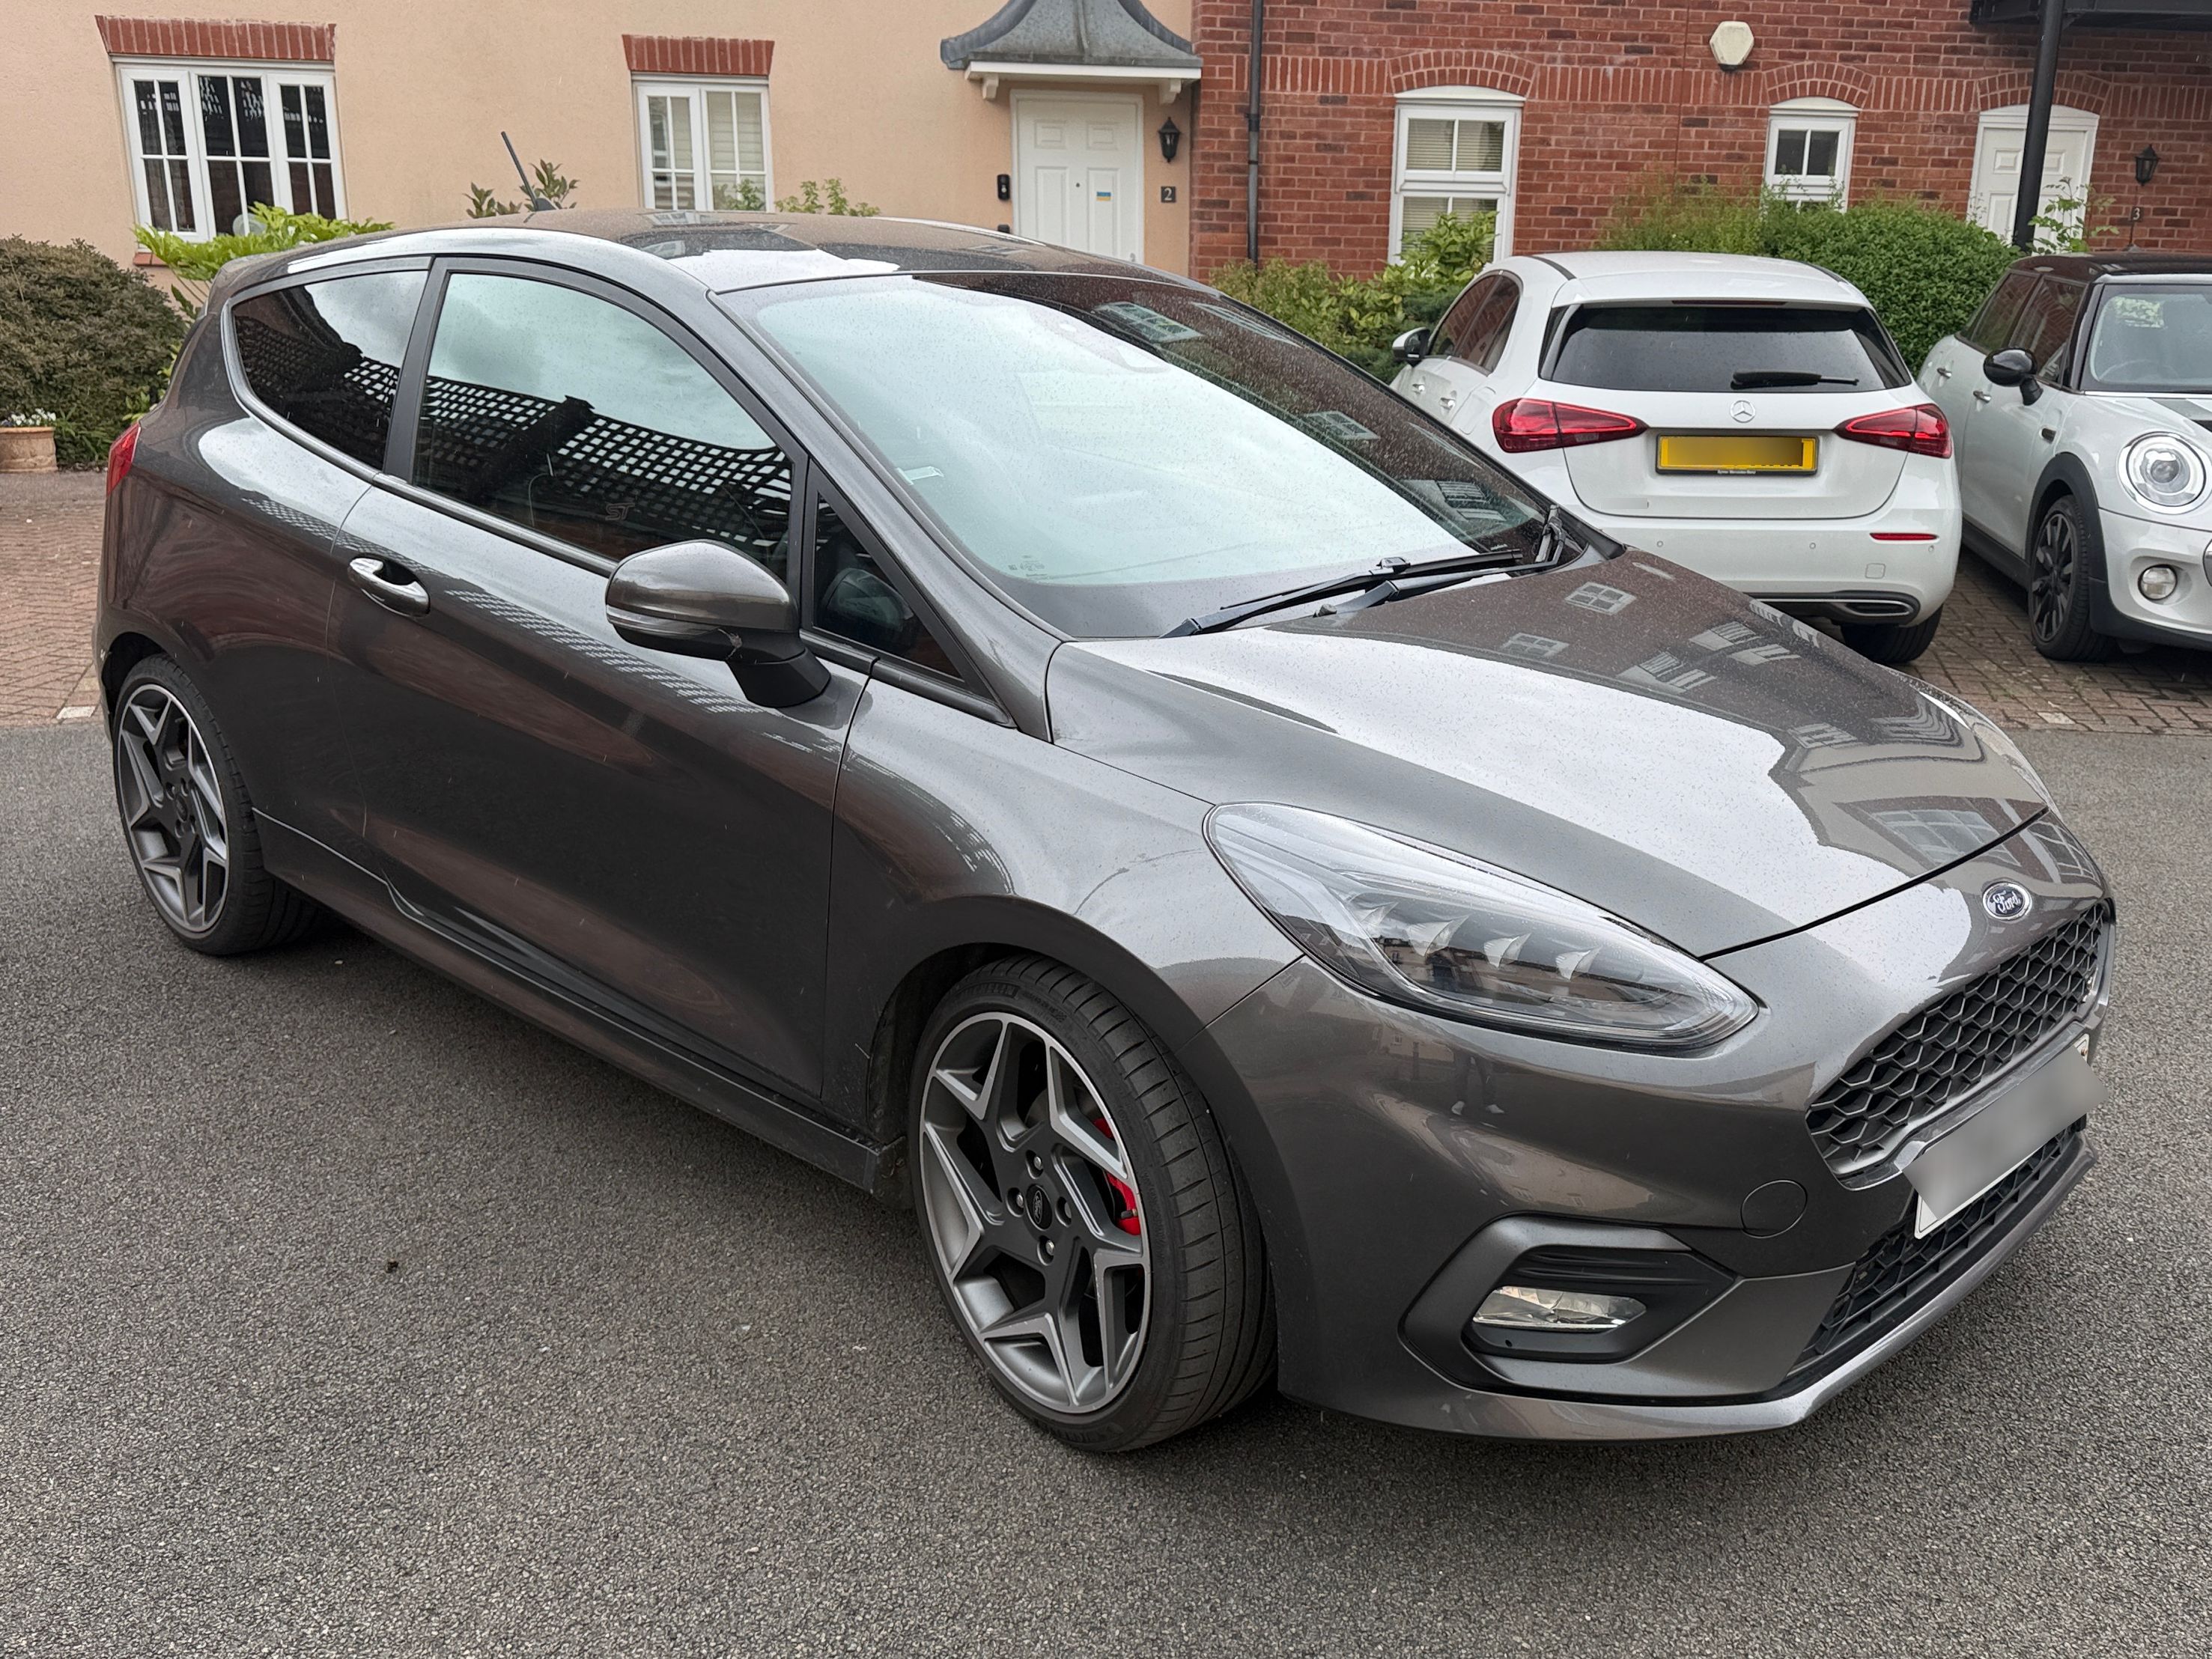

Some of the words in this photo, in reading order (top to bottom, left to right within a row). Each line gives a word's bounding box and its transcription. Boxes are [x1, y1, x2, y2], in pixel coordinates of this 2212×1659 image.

[1164, 187, 1173, 201] 2
[2133, 207, 2140, 220] 3
[605, 502, 635, 521] ST
[1990, 889, 2022, 914] Ford
